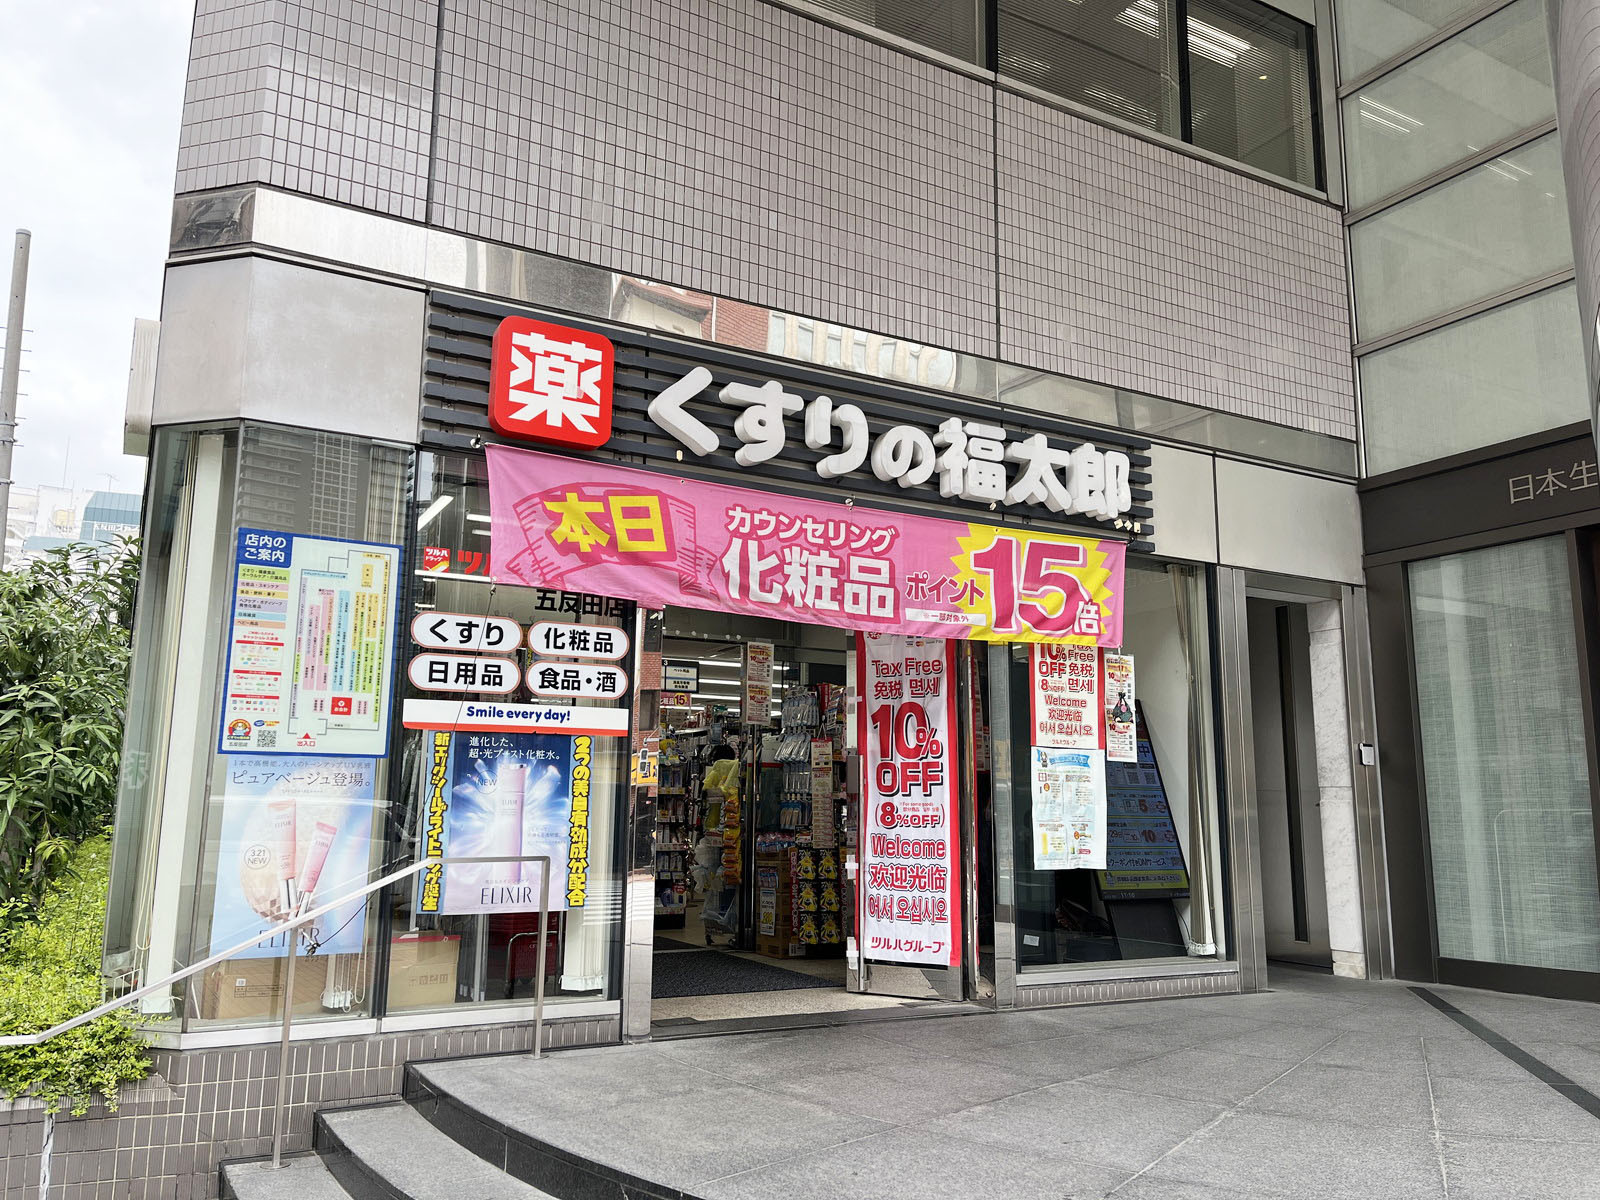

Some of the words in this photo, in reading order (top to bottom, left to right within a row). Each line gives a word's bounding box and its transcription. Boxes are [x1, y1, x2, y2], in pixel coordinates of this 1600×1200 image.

[508, 331, 603, 434] 薬
[647, 366, 1132, 522] くすりの福太郎
[1508, 459, 1599, 505] 日本生
[542, 491, 669, 553] 本日
[726, 505, 896, 553] カウンセリング
[244, 533, 287, 548] 店内の
[425, 548, 449, 558] ツルハ
[244, 547, 285, 562] ご案内
[721, 538, 895, 620] 化粧品
[904, 570, 986, 606] ポイント
[534, 588, 625, 618] 五反田店
[429, 618, 505, 646] くすり
[543, 627, 614, 654] 化粧品
[872, 660, 902, 677] Tax
[904, 657, 943, 675] Free
[1068, 649, 1095, 662] Free
[428, 661, 504, 687] 日用品
[538, 667, 617, 693] 食品・酒
[1038, 660, 1067, 678] OFF
[874, 680, 903, 699] 免税
[909, 676, 941, 698] 면세
[466, 705, 504, 718] Smile
[506, 709, 542, 723] every
[543, 704, 571, 722] day!
[1044, 694, 1087, 708] Welcome
[469, 736, 515, 748] 進化した、
[871, 701, 943, 761] 10%
[232, 769, 371, 787] ピュアベージュ登場。
[876, 761, 943, 797] OFF
[566, 735, 592, 907] 2つの美白有効成分配合
[870, 833, 947, 859] Welcome
[247, 856, 267, 865] NEW
[868, 863, 948, 892] 欢迎光临
[480, 886, 532, 905] ELIXIR
[868, 894, 895, 923] 어서
[895, 896, 949, 924] 오십시오
[871, 936, 945, 954] ツルハグループ
